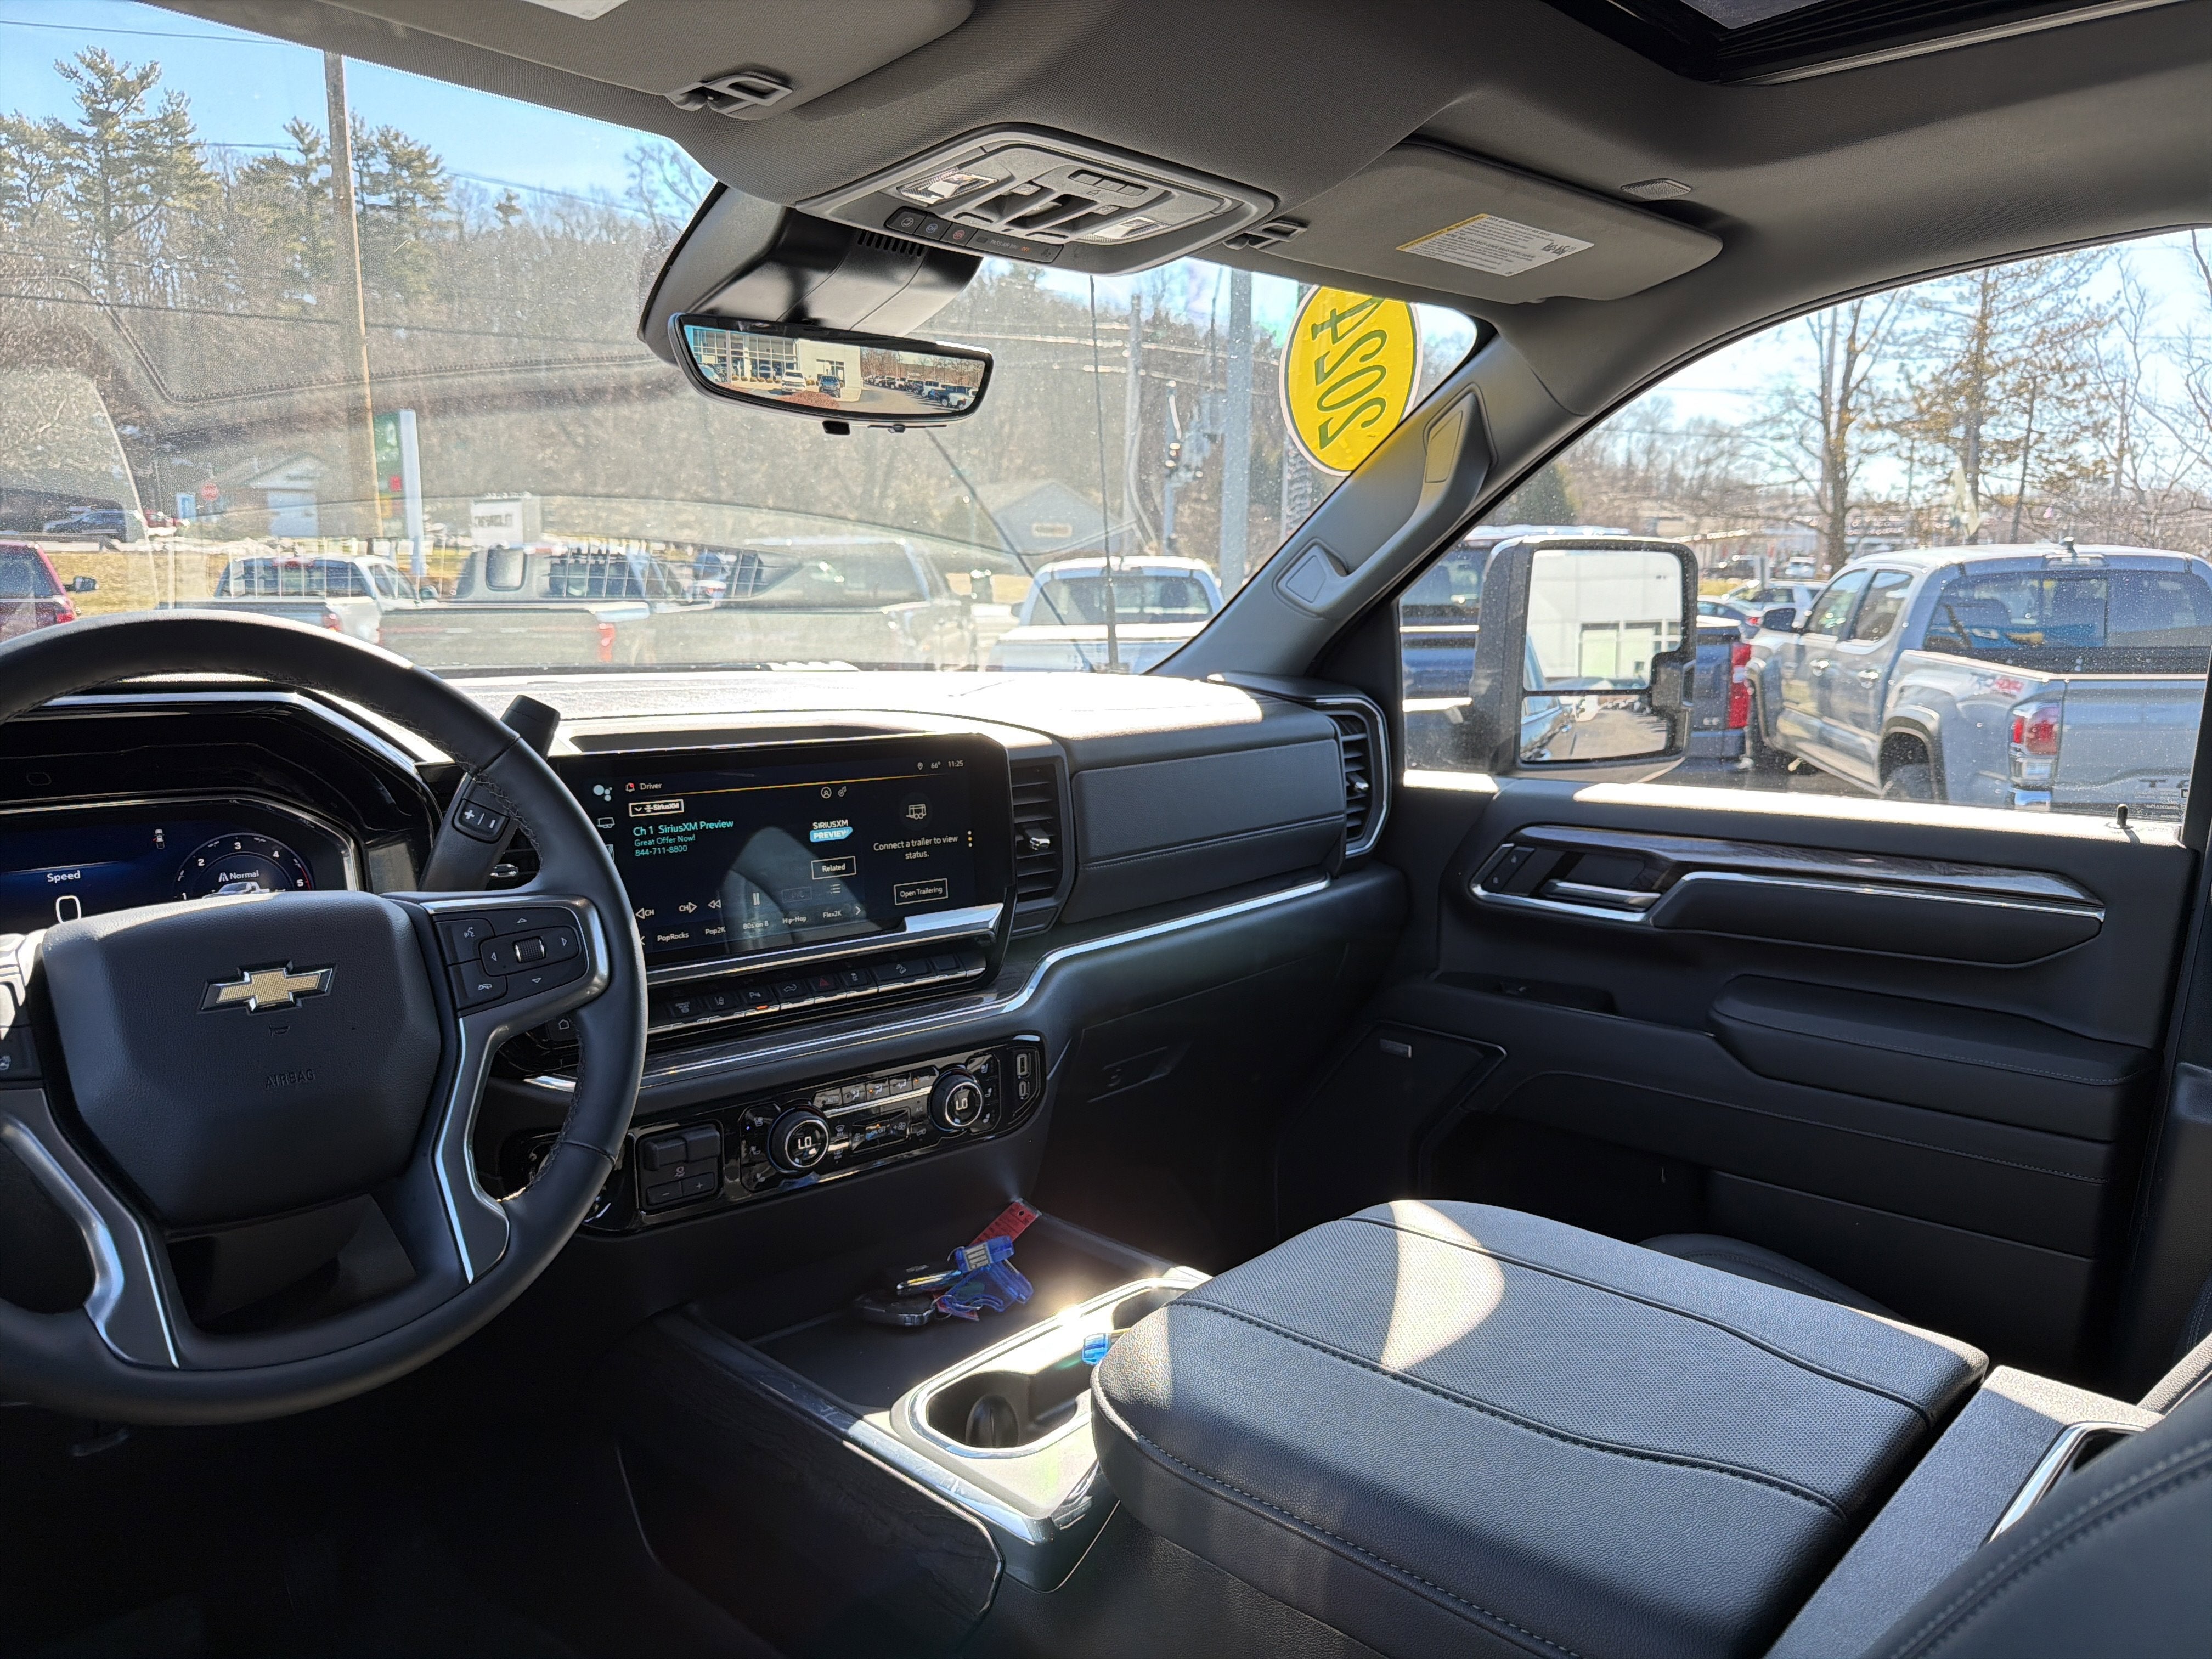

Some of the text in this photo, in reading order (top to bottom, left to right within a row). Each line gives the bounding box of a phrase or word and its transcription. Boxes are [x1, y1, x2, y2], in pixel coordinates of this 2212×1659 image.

[653, 803, 680, 811] SiriusXM
[633, 820, 734, 836] Ch 1 SiriusXM Preview
[812, 819, 849, 830] SIRIUSXM
[813, 830, 848, 839] PREVIEW
[634, 834, 696, 847] Great Offer Now!
[873, 840, 905, 851] Connect
[911, 838, 932, 847] trailer
[942, 835, 958, 844] view
[234, 842, 241, 850] 3
[634, 845, 688, 857] 844-711-8800
[905, 850, 930, 860] status.
[822, 862, 846, 872] Related
[47, 871, 81, 883] Speed
[229, 870, 259, 880] Normal
[297, 879, 304, 887] 5
[182, 892, 187, 900] 1
[900, 884, 943, 898] Open Trailering
[55, 896, 82, 923] 0
[823, 910, 842, 918] Flex2K
[782, 916, 807, 926] Hip-Hop
[705, 926, 726, 935] Pop2K
[657, 932, 690, 942] PopRocks
[265, 1069, 315, 1089] AIRBAG
[956, 1098, 968, 1110] LO
[798, 1136, 812, 1150] LO
